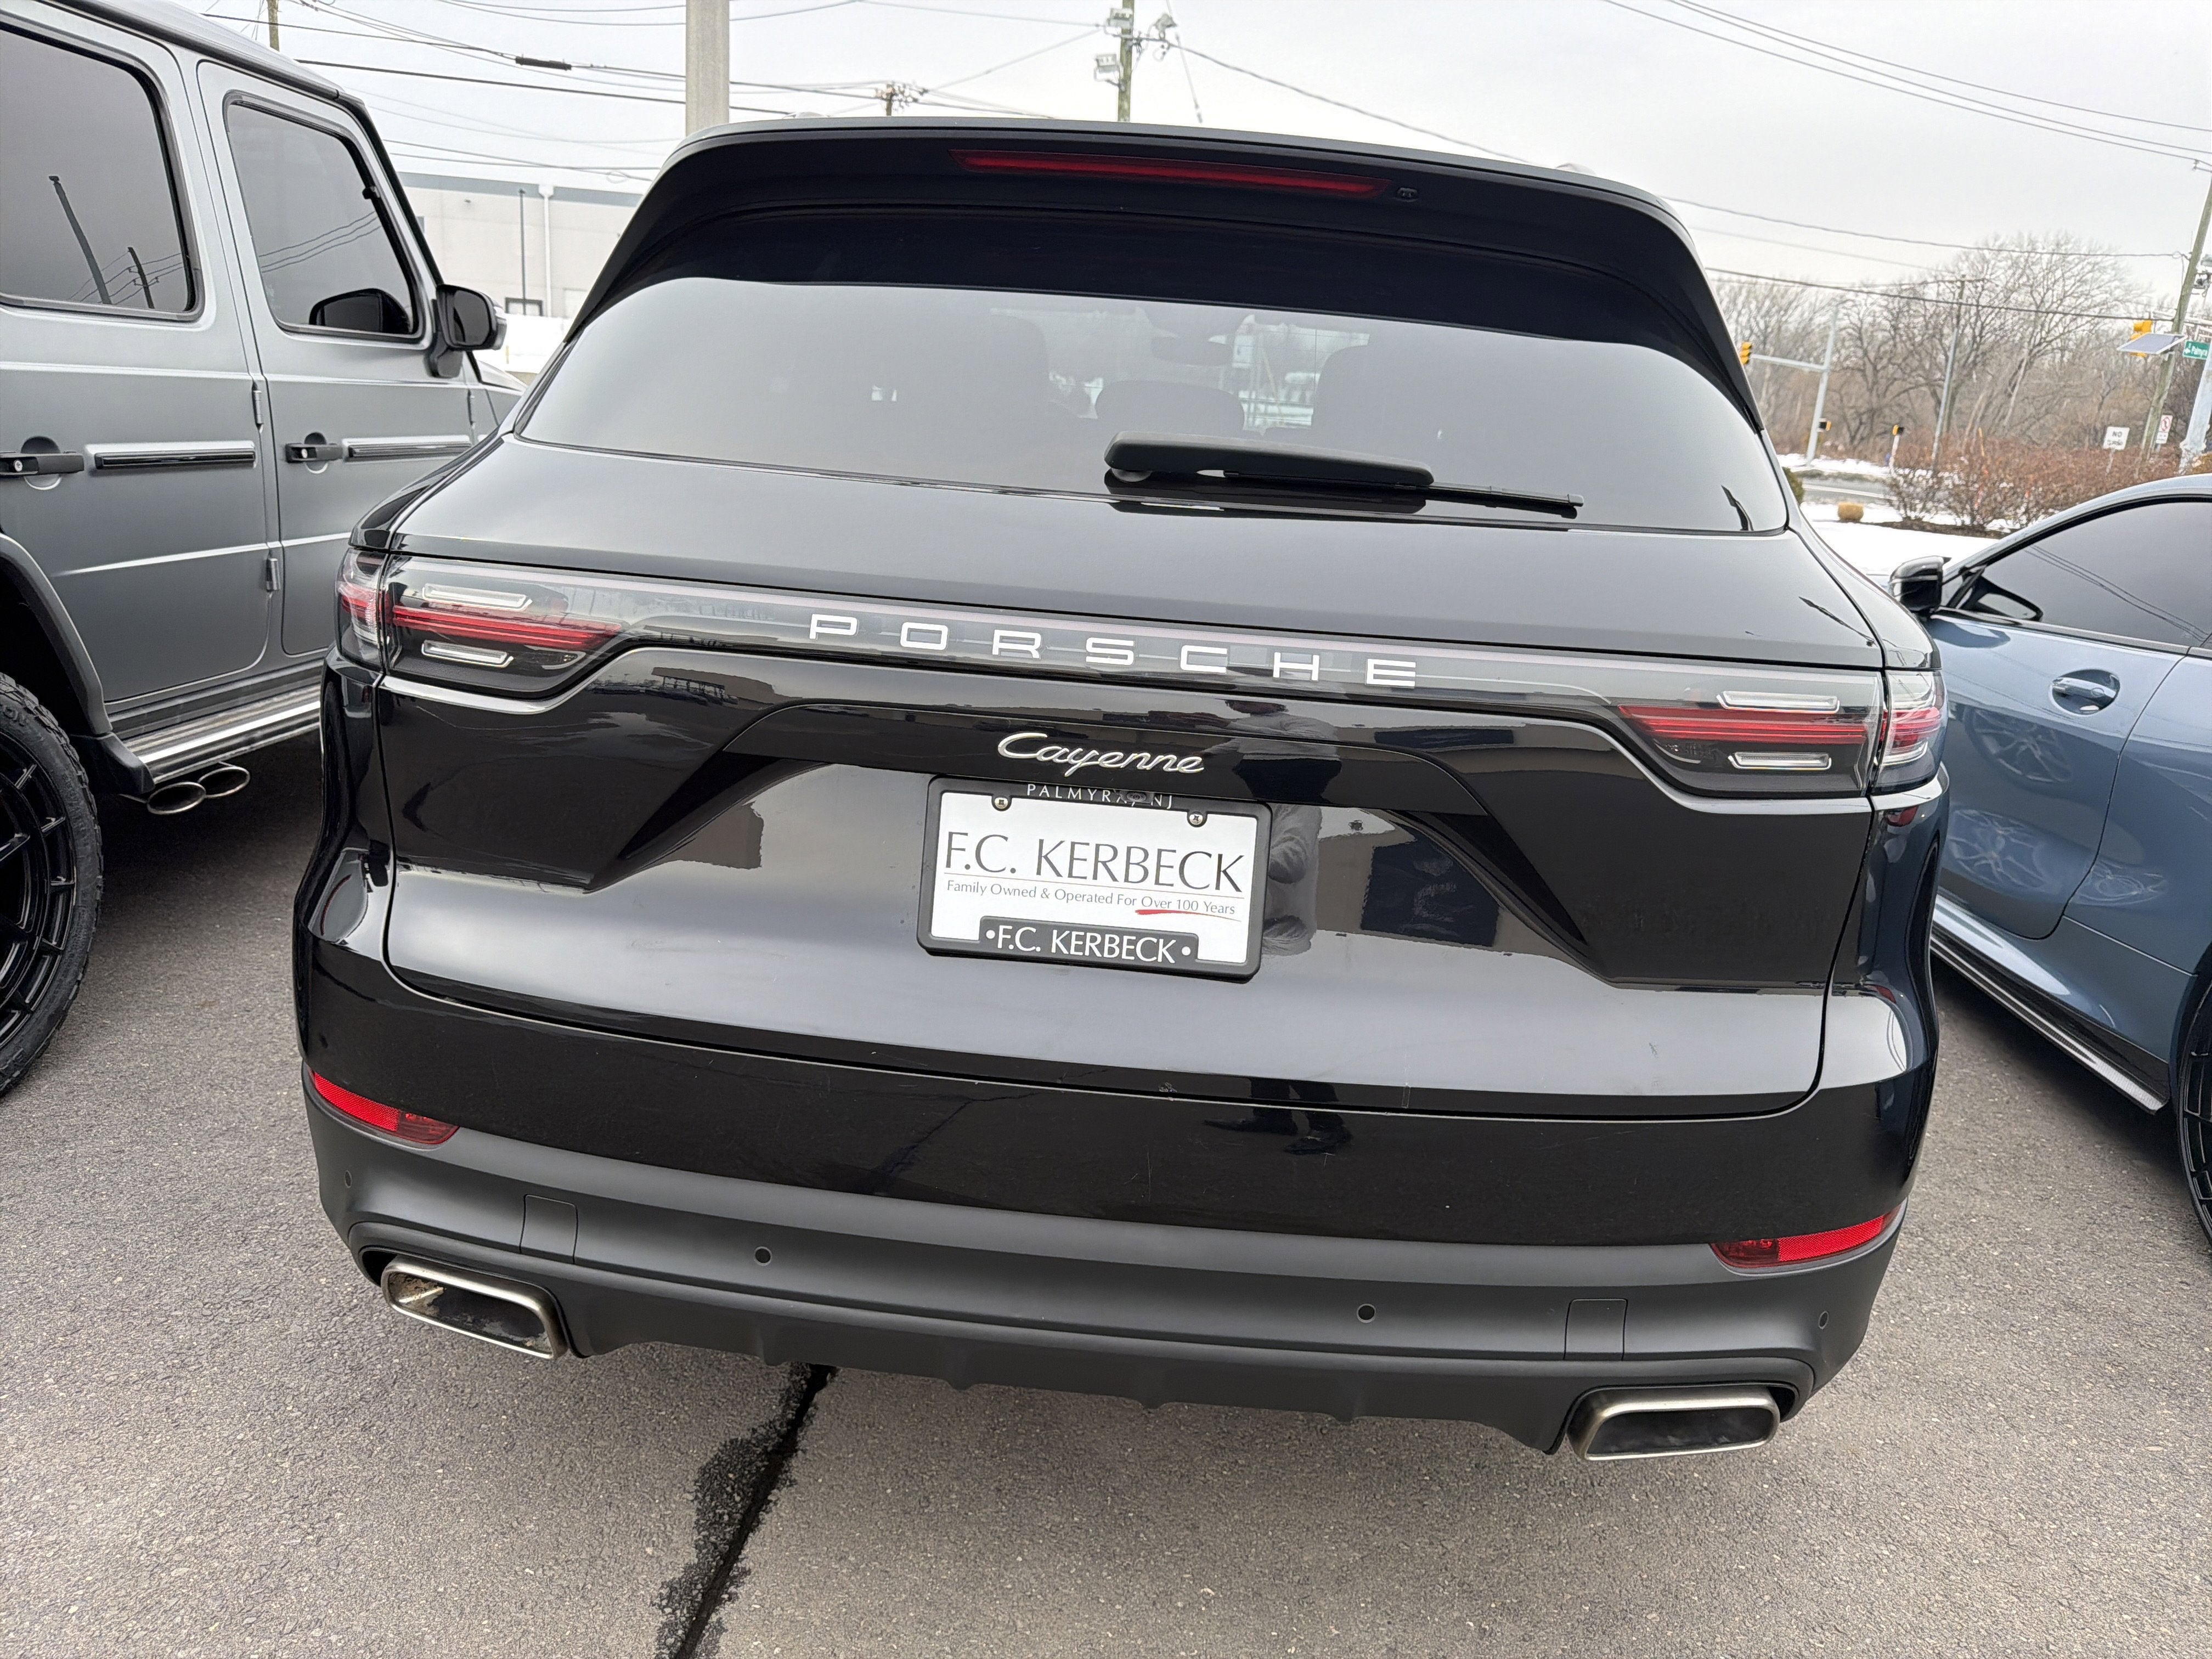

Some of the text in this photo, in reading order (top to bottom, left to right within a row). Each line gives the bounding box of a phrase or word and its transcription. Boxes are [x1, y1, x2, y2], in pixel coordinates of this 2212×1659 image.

[809, 613, 1416, 687] PORSCHE
[998, 732, 1205, 777] Cayenne
[1151, 794, 1172, 809] NJ
[945, 831, 1245, 893] F.C. KERBECK
[947, 880, 1235, 915] Family Owned & Operated For Over 100 Years
[997, 925, 1176, 963] F.C. KERBECK
